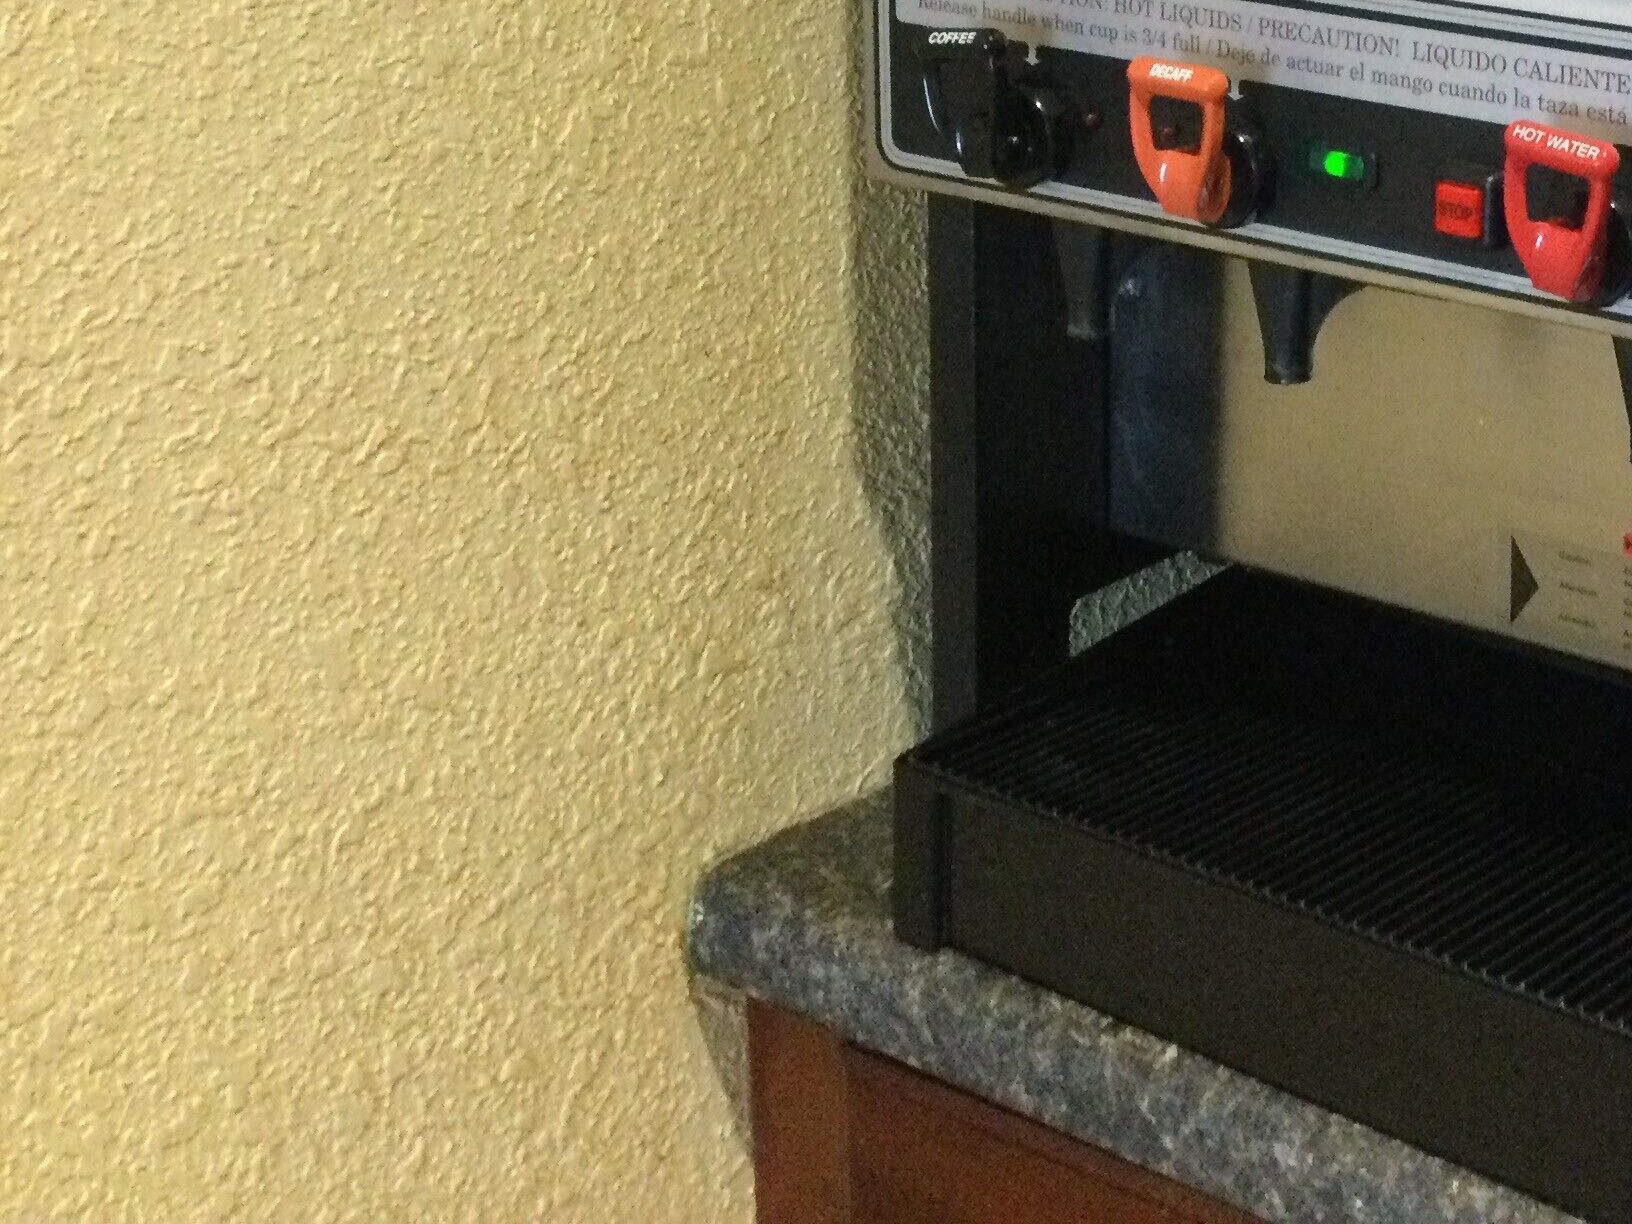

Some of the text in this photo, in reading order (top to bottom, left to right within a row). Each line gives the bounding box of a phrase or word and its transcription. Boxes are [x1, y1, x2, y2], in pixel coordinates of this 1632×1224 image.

[928, 31, 977, 45] COFFEE
[982, 0, 1036, 26] handle
[1041, 13, 1084, 37] when
[1089, 23, 1118, 44] cup
[1123, 26, 1138, 43] is
[1142, 27, 1166, 48] 3/4
[1172, 32, 1200, 54] full
[1216, 39, 1256, 65] Deje
[1260, 47, 1281, 66] de
[1286, 54, 1345, 77] actuar
[1349, 62, 1365, 81] el
[1371, 69, 1433, 95] mango
[1438, 79, 1507, 105] cuando
[1513, 87, 1530, 109] la
[1538, 93, 1579, 116] taza
[1586, 102, 1627, 126] está
[1159, 1, 1242, 32] LIQUIDS
[1412, 41, 1507, 74] LIQUIDO
[1513, 57, 1631, 95] CALIENTE
[1512, 125, 1600, 161] HOT WATER
